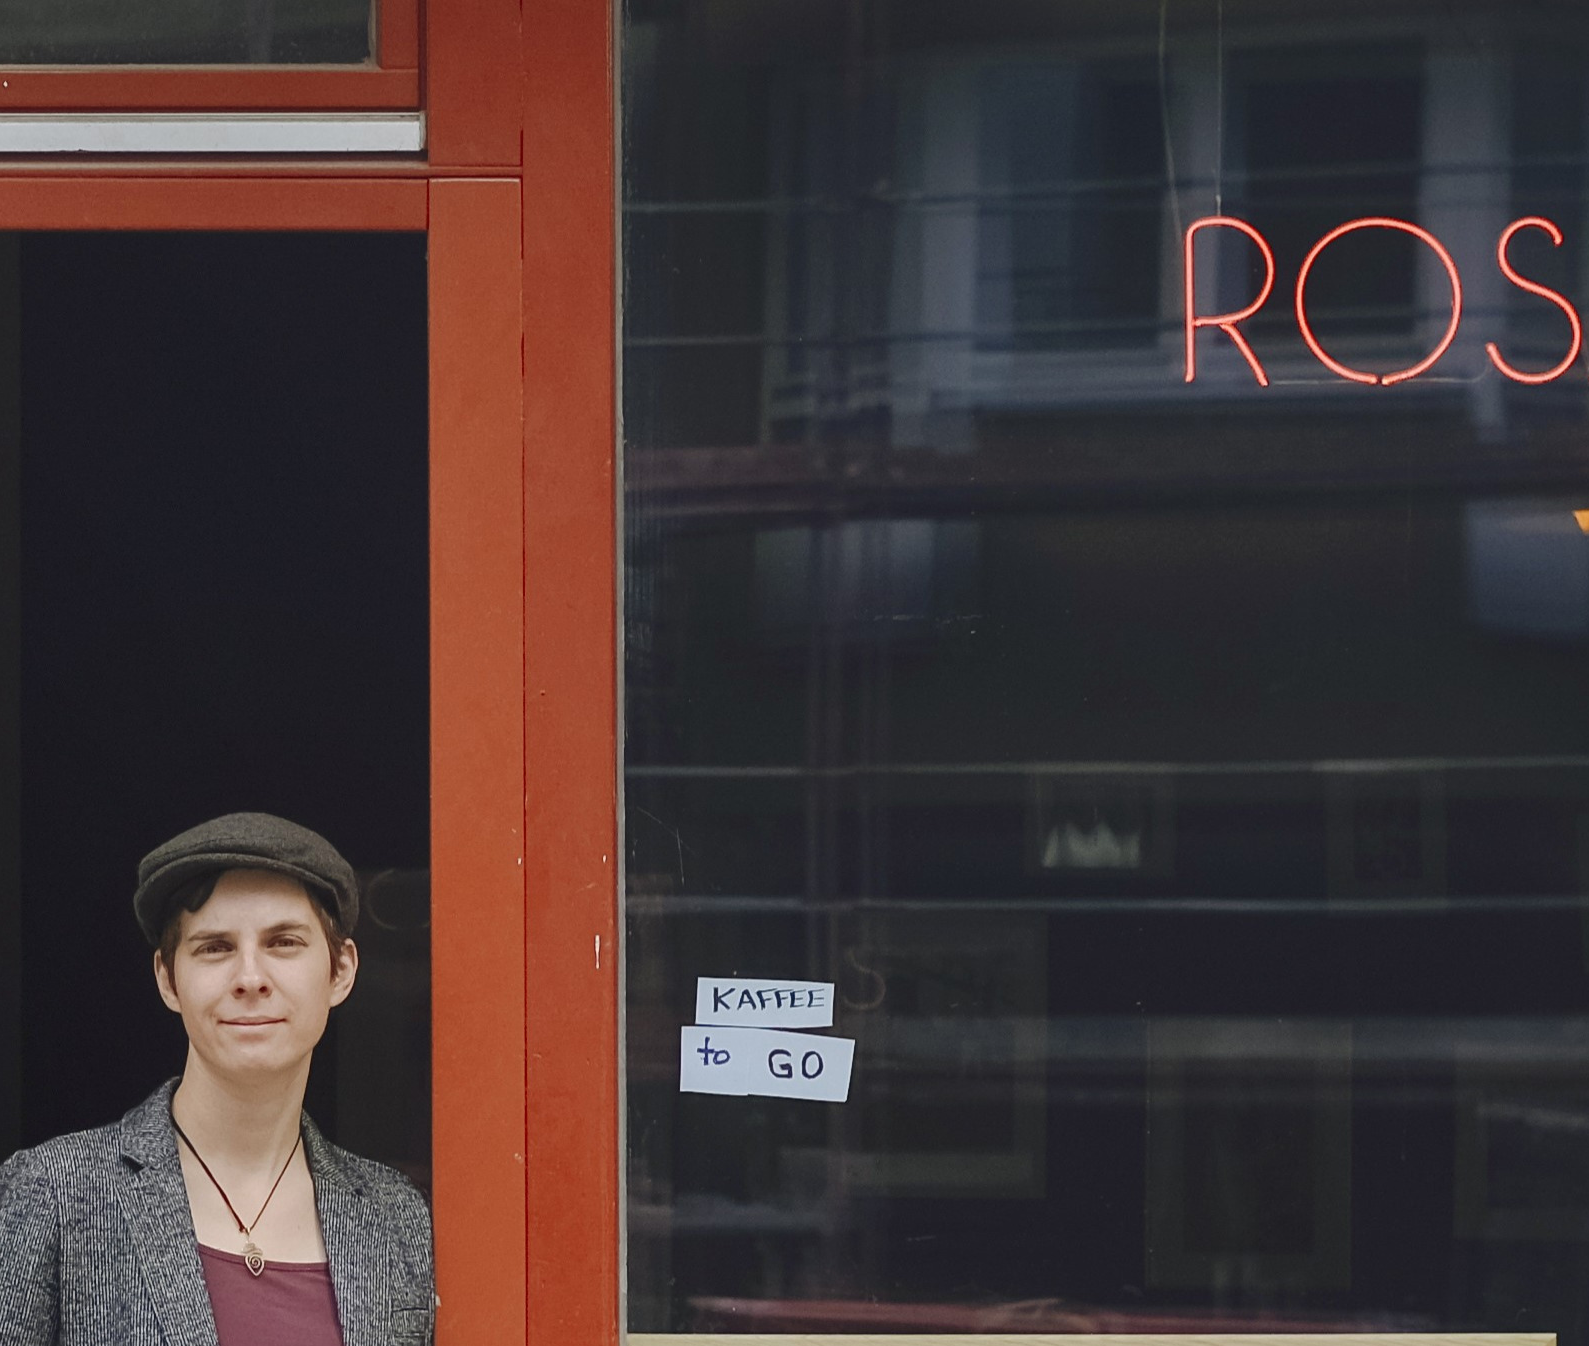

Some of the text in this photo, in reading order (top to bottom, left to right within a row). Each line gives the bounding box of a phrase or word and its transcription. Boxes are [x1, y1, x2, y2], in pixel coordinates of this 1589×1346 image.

[713, 986, 825, 1013] KAFFEE
[696, 1036, 824, 1080] to GO
